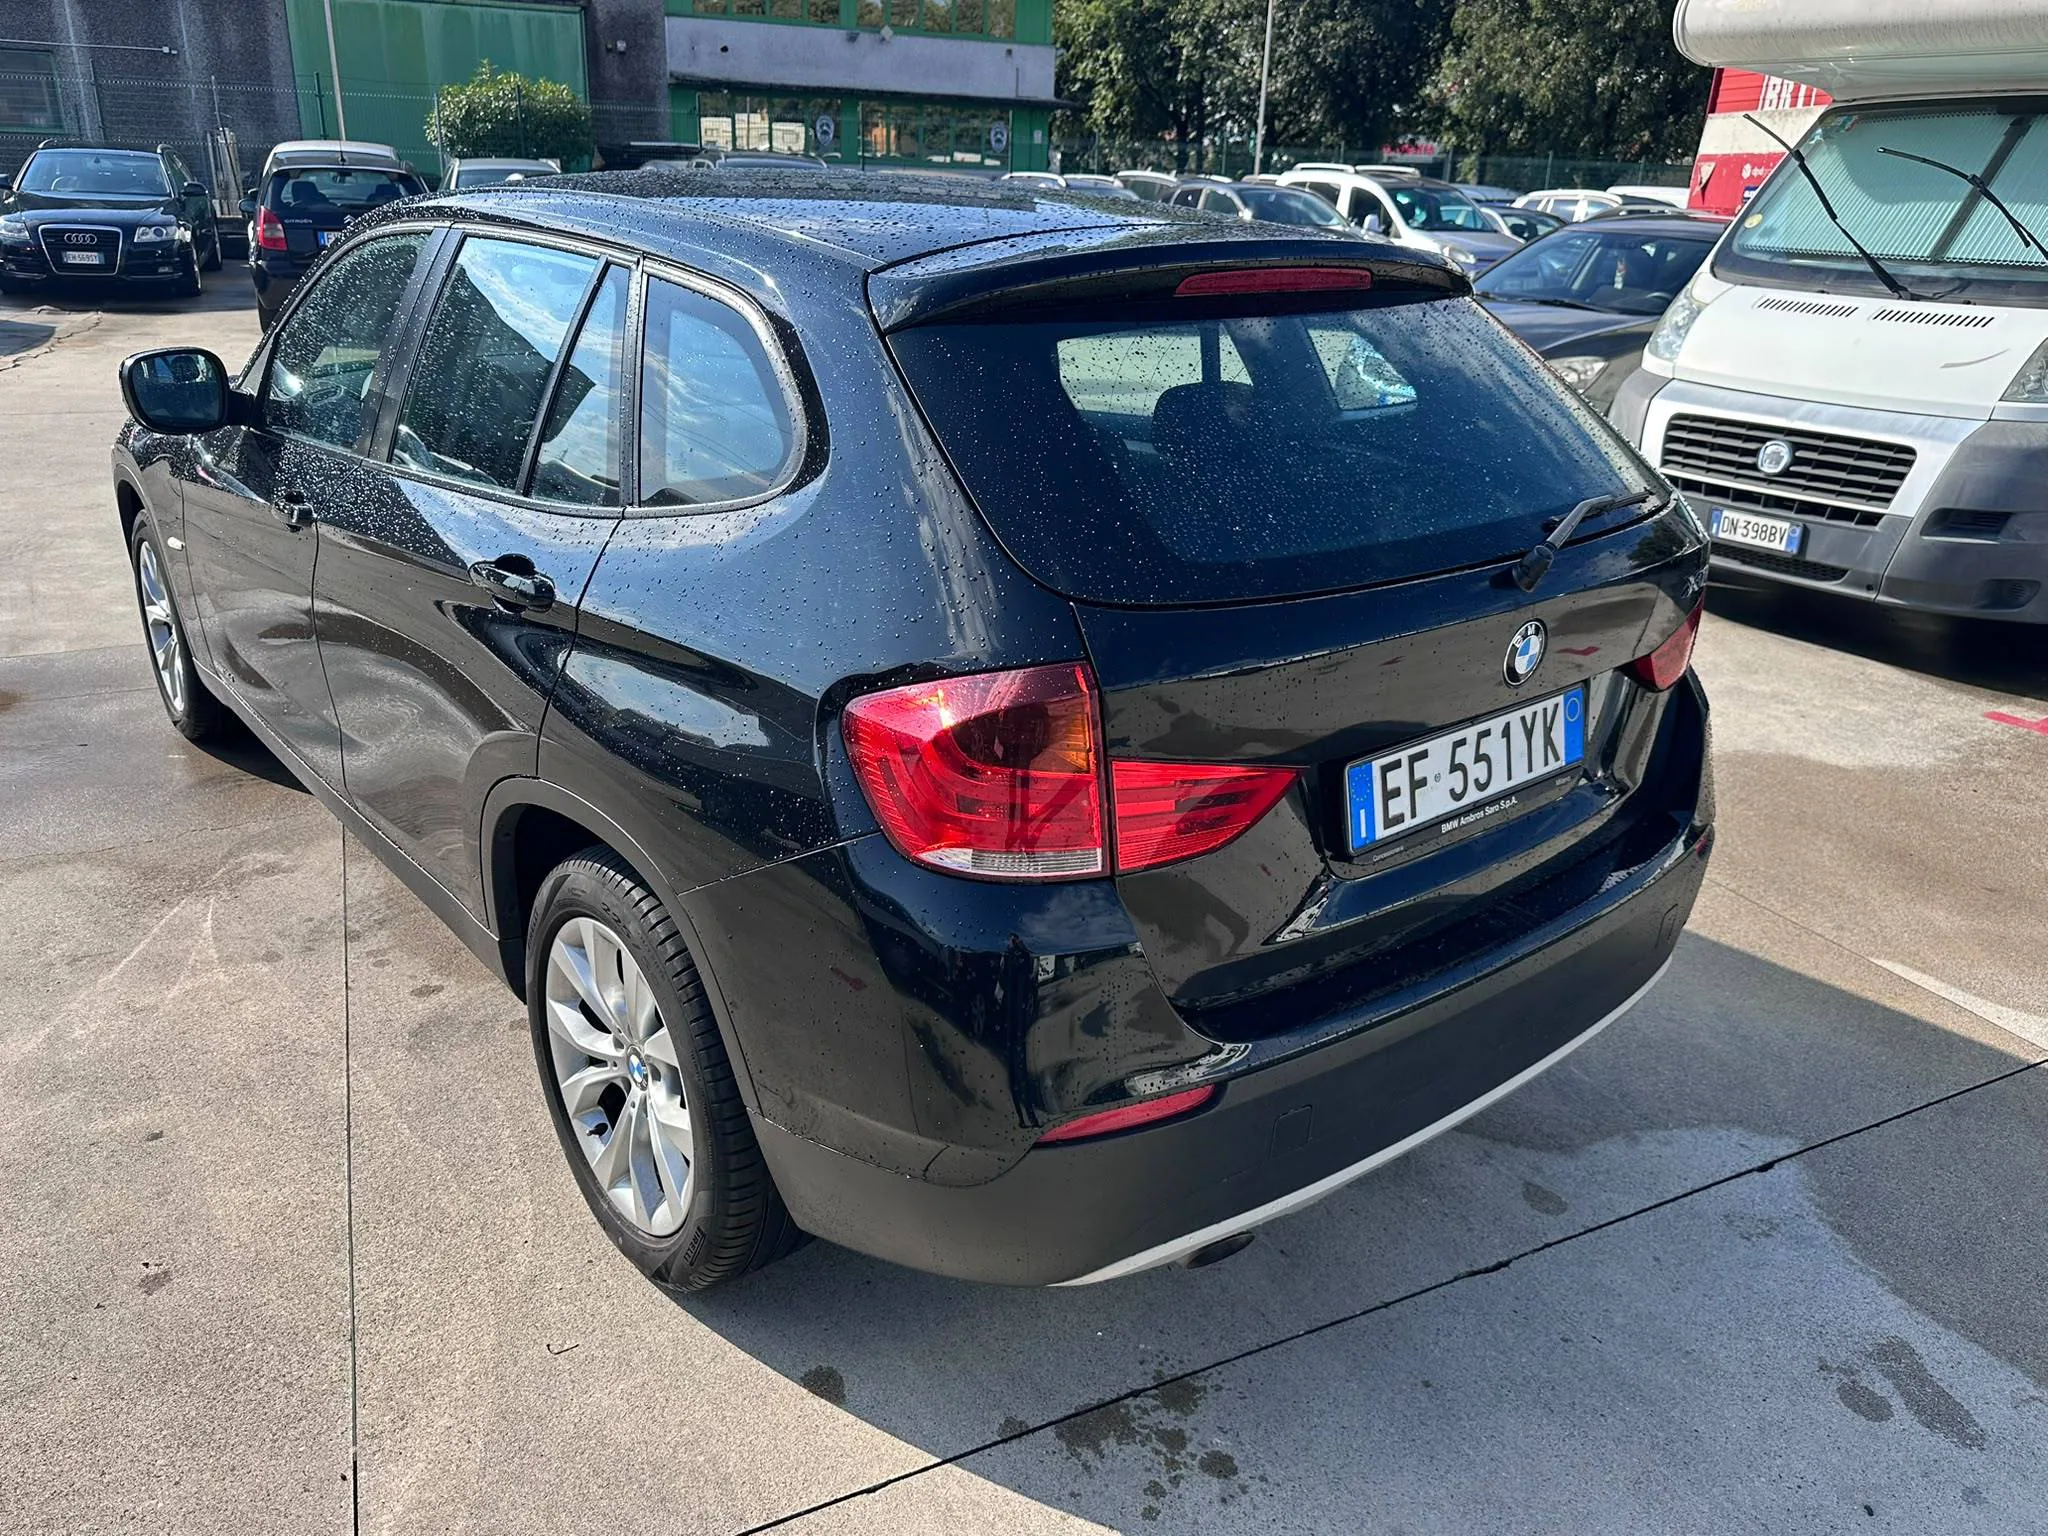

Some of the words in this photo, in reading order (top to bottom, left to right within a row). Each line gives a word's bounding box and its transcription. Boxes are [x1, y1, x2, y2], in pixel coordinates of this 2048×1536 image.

[1721, 516, 1739, 536] DN
[1741, 520, 1787, 545] 398BV
[1379, 748, 1430, 831] EF
[1448, 702, 1562, 803] 551YK
[1441, 819, 1459, 834] BMW
[1460, 810, 1484, 826] Ambros
[683, 1225, 708, 1267] PIRELLI
